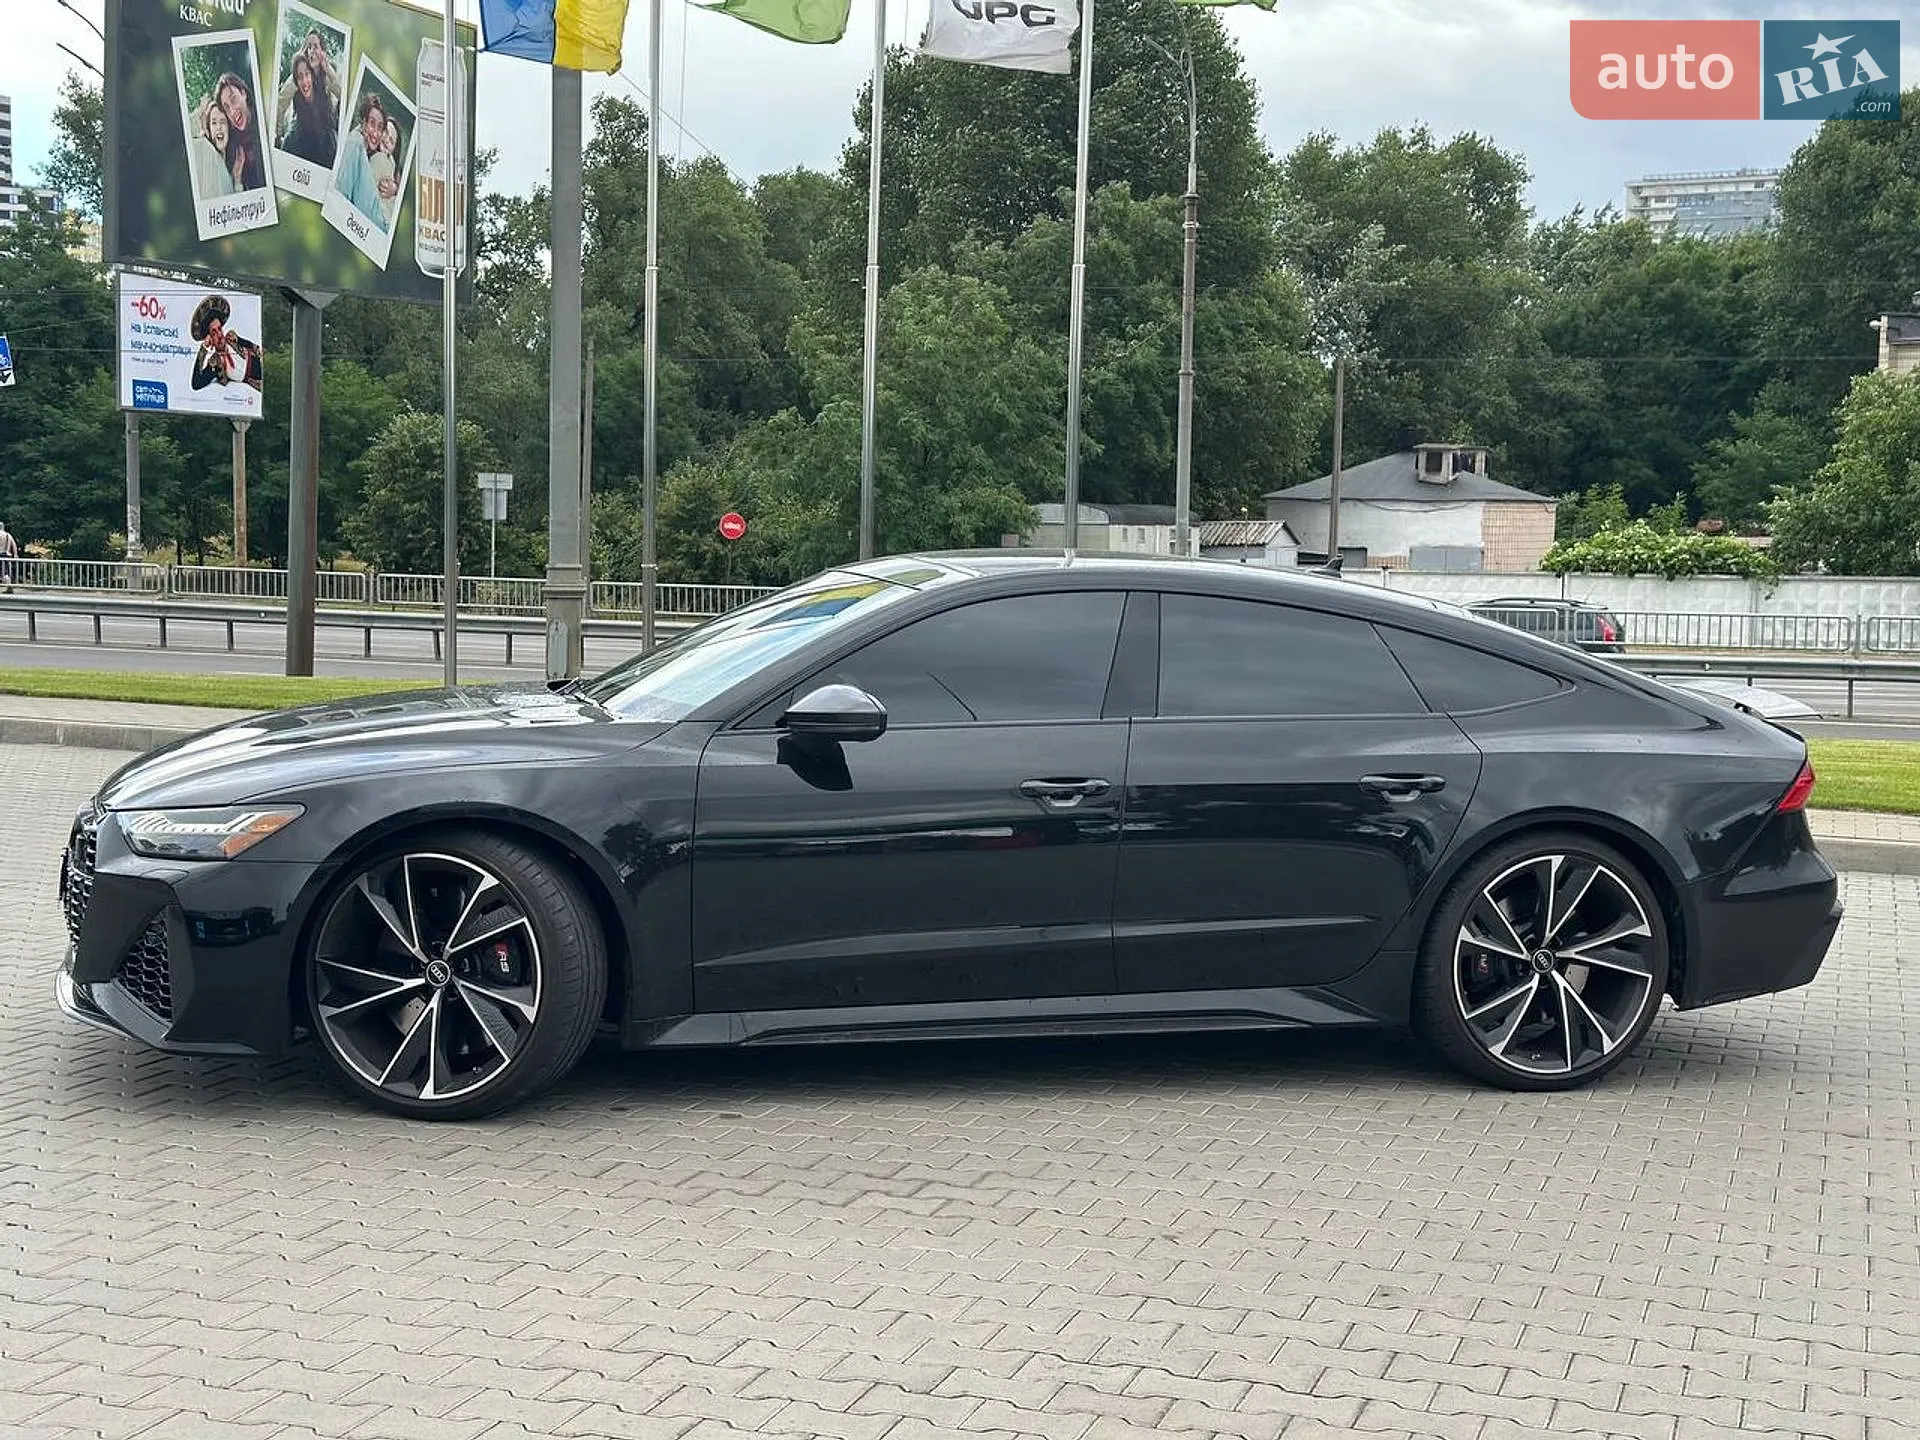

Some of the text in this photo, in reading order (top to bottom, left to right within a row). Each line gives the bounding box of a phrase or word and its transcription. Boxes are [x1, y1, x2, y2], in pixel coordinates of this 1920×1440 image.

[179, 5, 213, 26] КВАС
[292, 168, 311, 186] свій
[209, 196, 265, 228] Нефільтруй
[346, 211, 370, 241] день!
[131, 295, 166, 320] -60%
